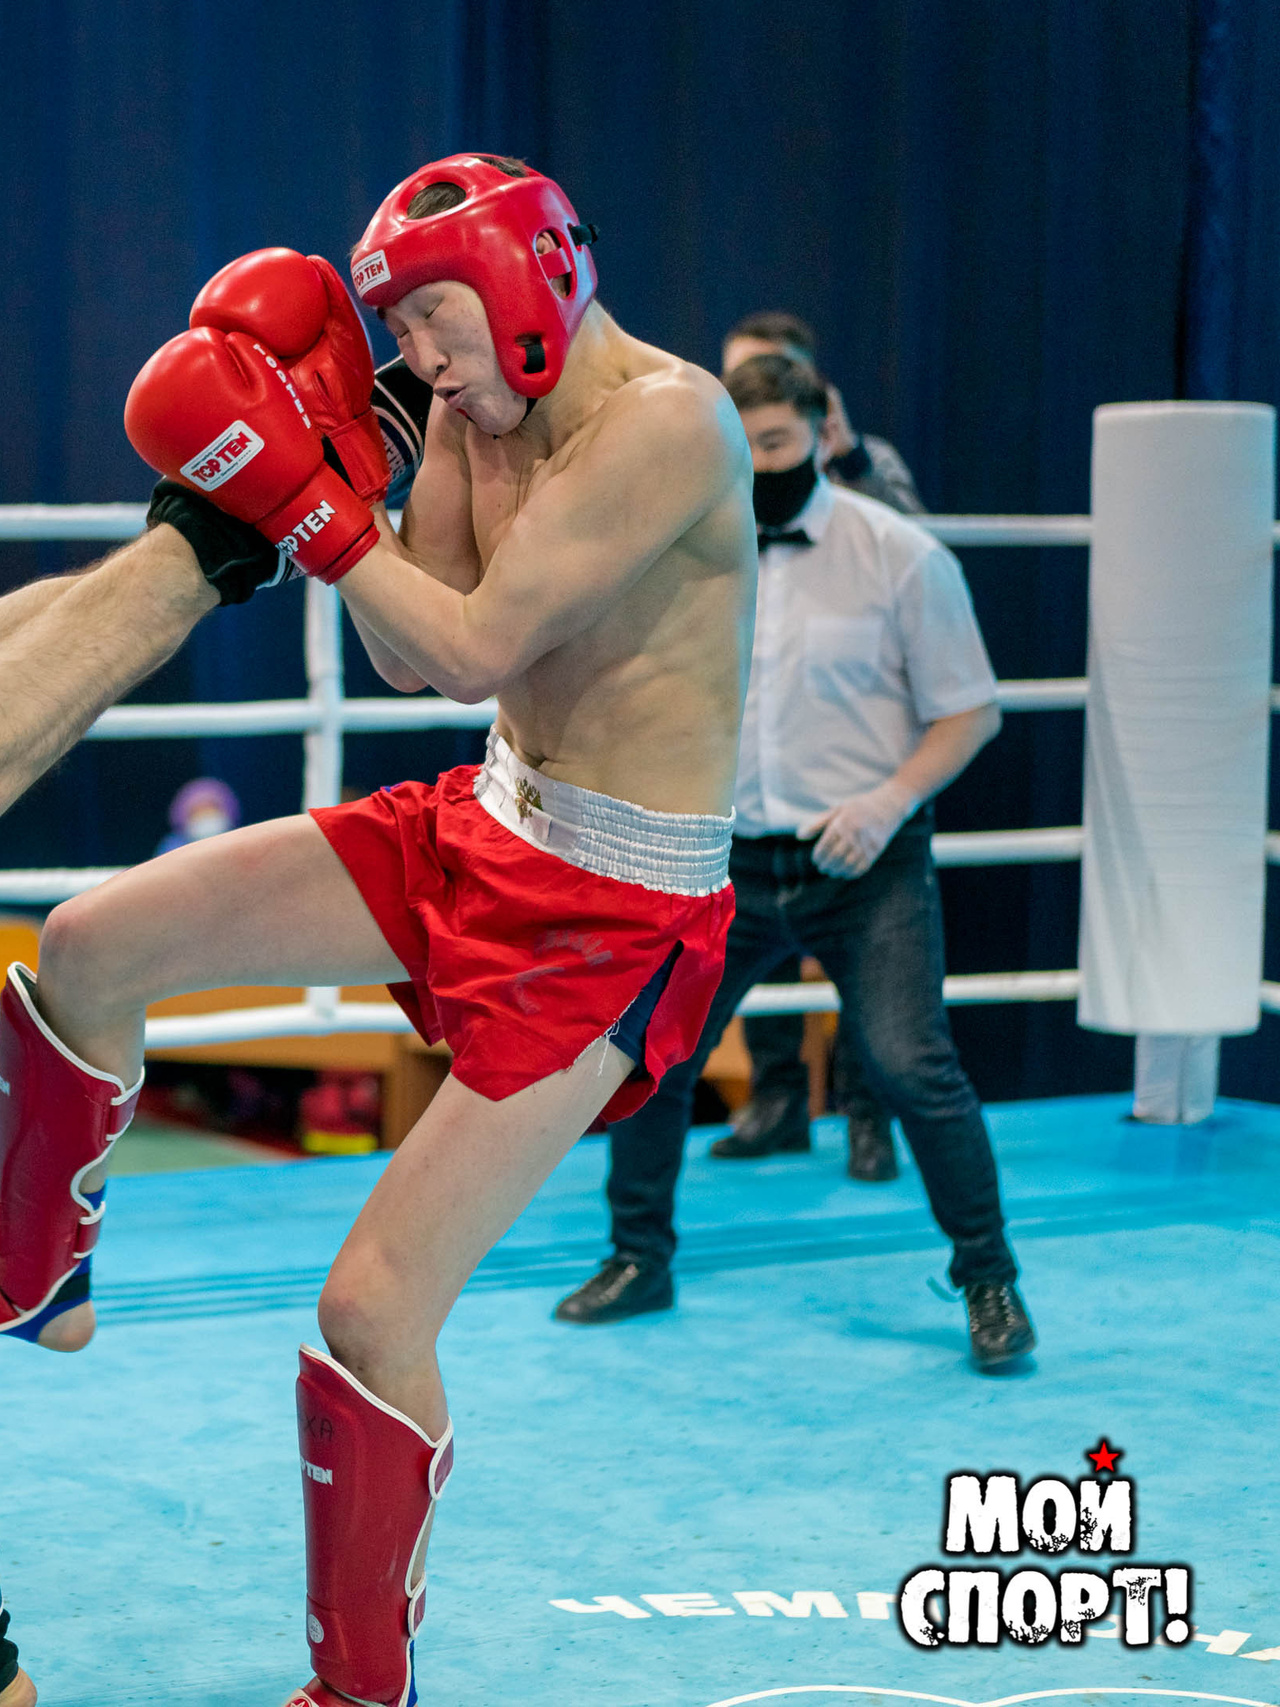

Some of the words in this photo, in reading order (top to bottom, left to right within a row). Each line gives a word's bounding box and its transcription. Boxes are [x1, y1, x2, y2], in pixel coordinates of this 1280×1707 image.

[364, 260, 385, 280] TEN
[191, 458, 222, 482] TOP
[215, 431, 253, 464] TEN
[292, 499, 337, 542] TEN
